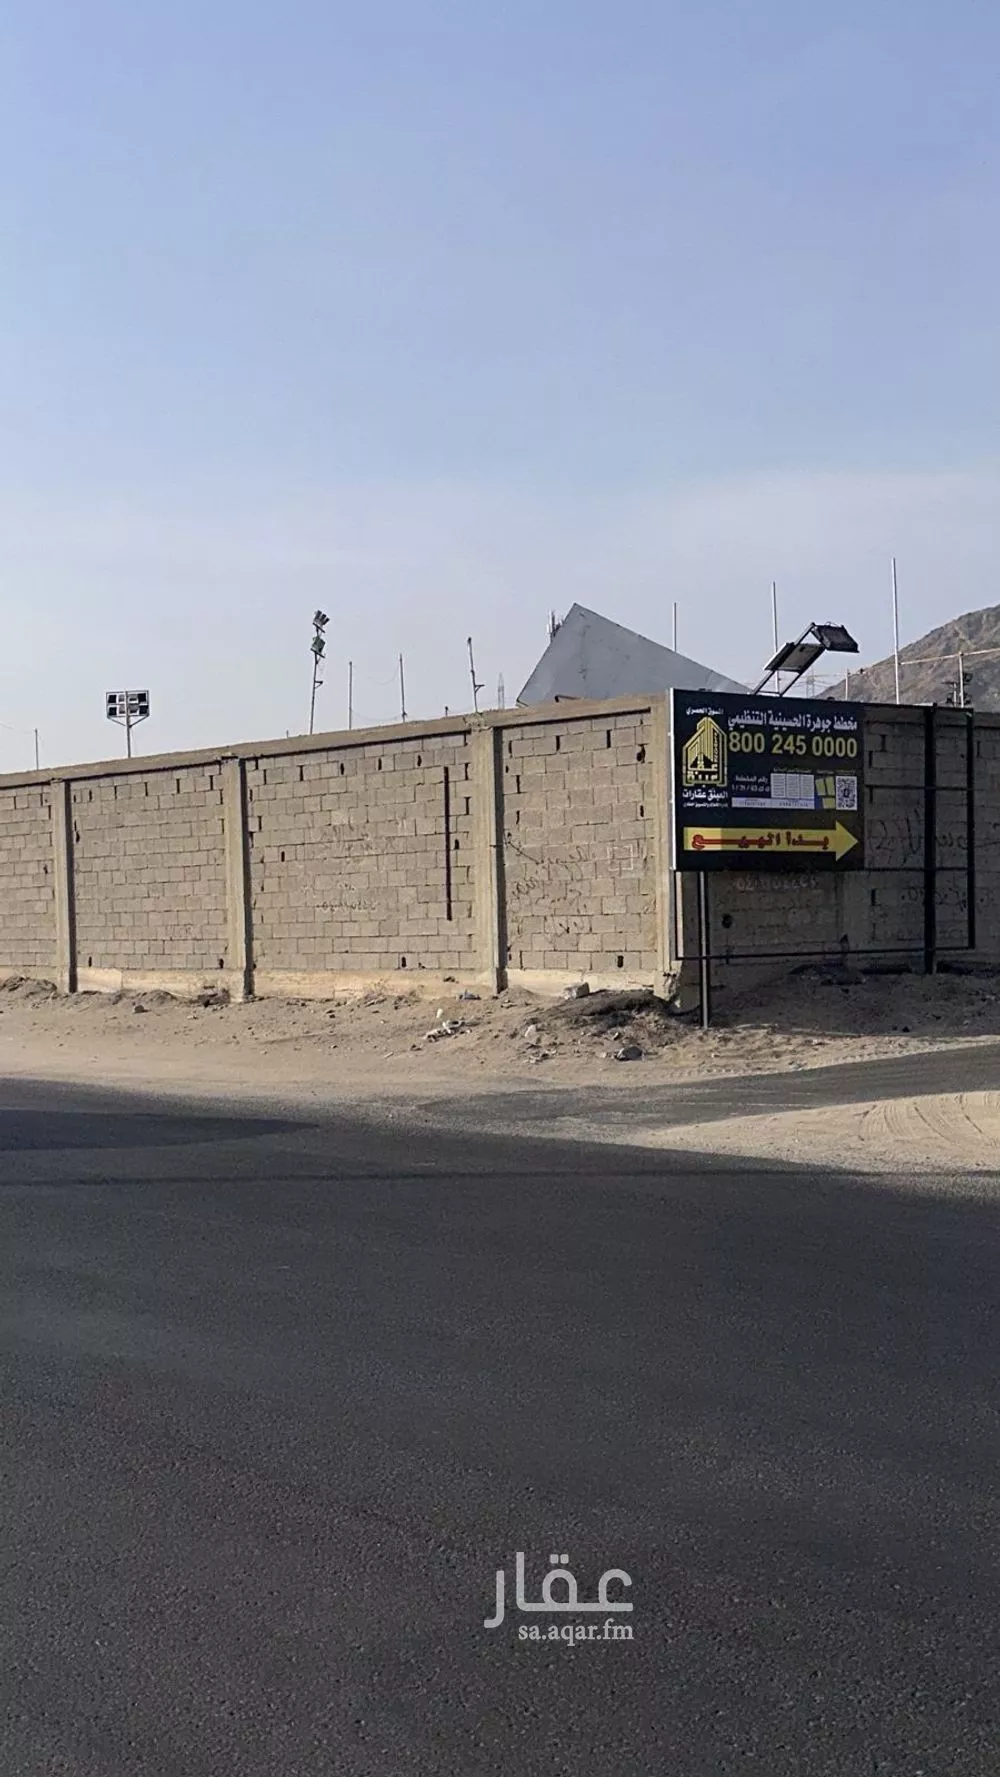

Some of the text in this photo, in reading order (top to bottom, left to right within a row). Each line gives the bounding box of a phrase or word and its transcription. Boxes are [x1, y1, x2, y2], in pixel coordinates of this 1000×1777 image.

[727, 709, 858, 733] مخطط جوهرة الحسينية التنظيمي
[728, 731, 765, 753] 800
[771, 734, 807, 755] 245
[812, 735, 859, 758] 0000
[682, 788, 707, 801] عقارات
